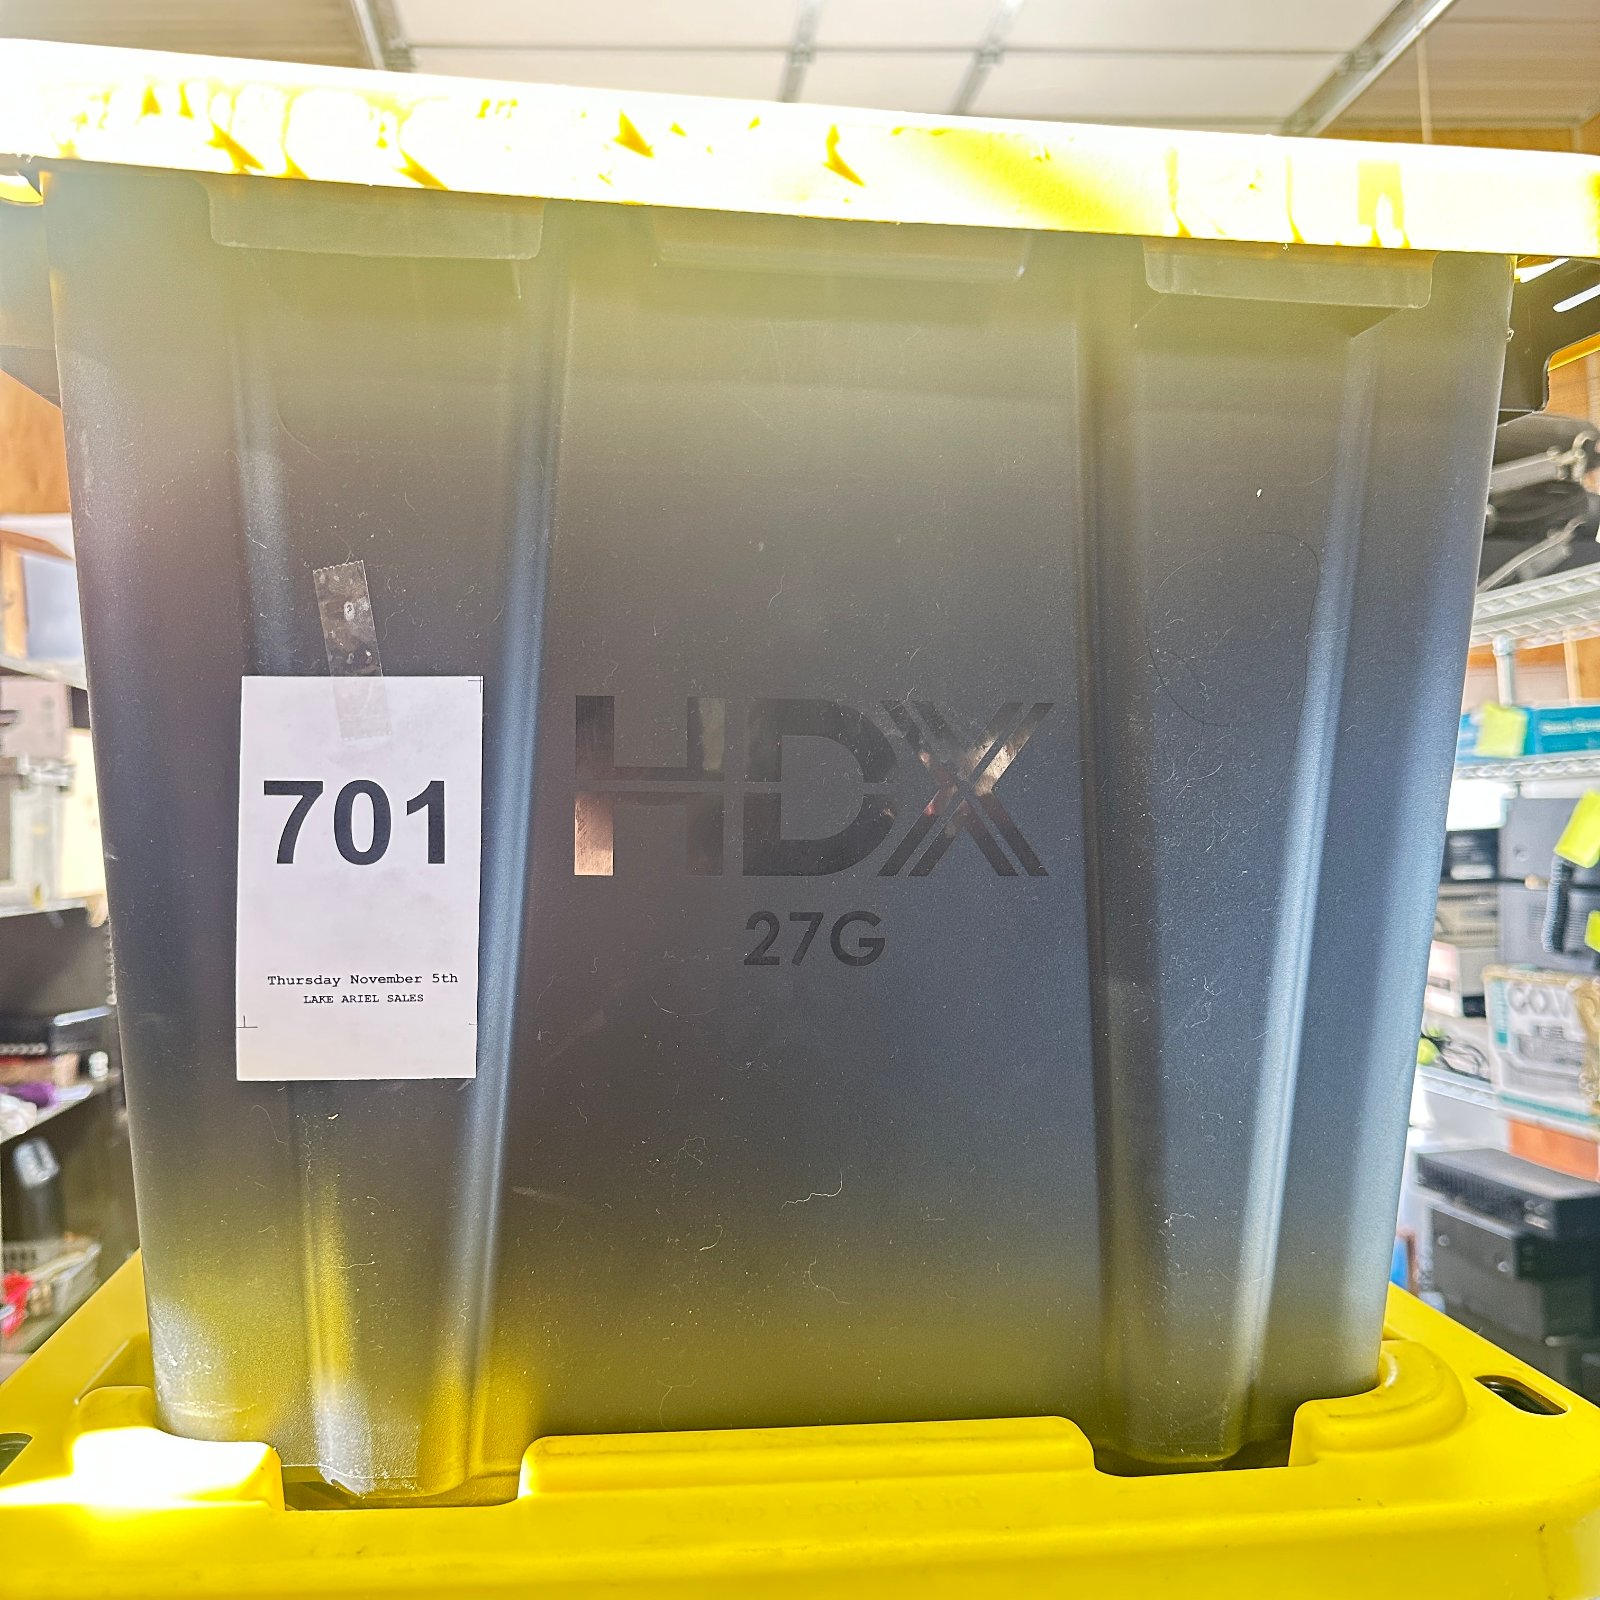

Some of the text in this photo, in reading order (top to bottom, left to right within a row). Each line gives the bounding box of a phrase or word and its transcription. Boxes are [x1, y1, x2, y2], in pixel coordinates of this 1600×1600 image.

[574, 695, 1054, 877] HDX
[263, 779, 447, 866] 701
[743, 911, 886, 967] 27G
[267, 973, 459, 987] Thursday November 5th
[303, 993, 424, 1004] LAKE ARIEL SALES
